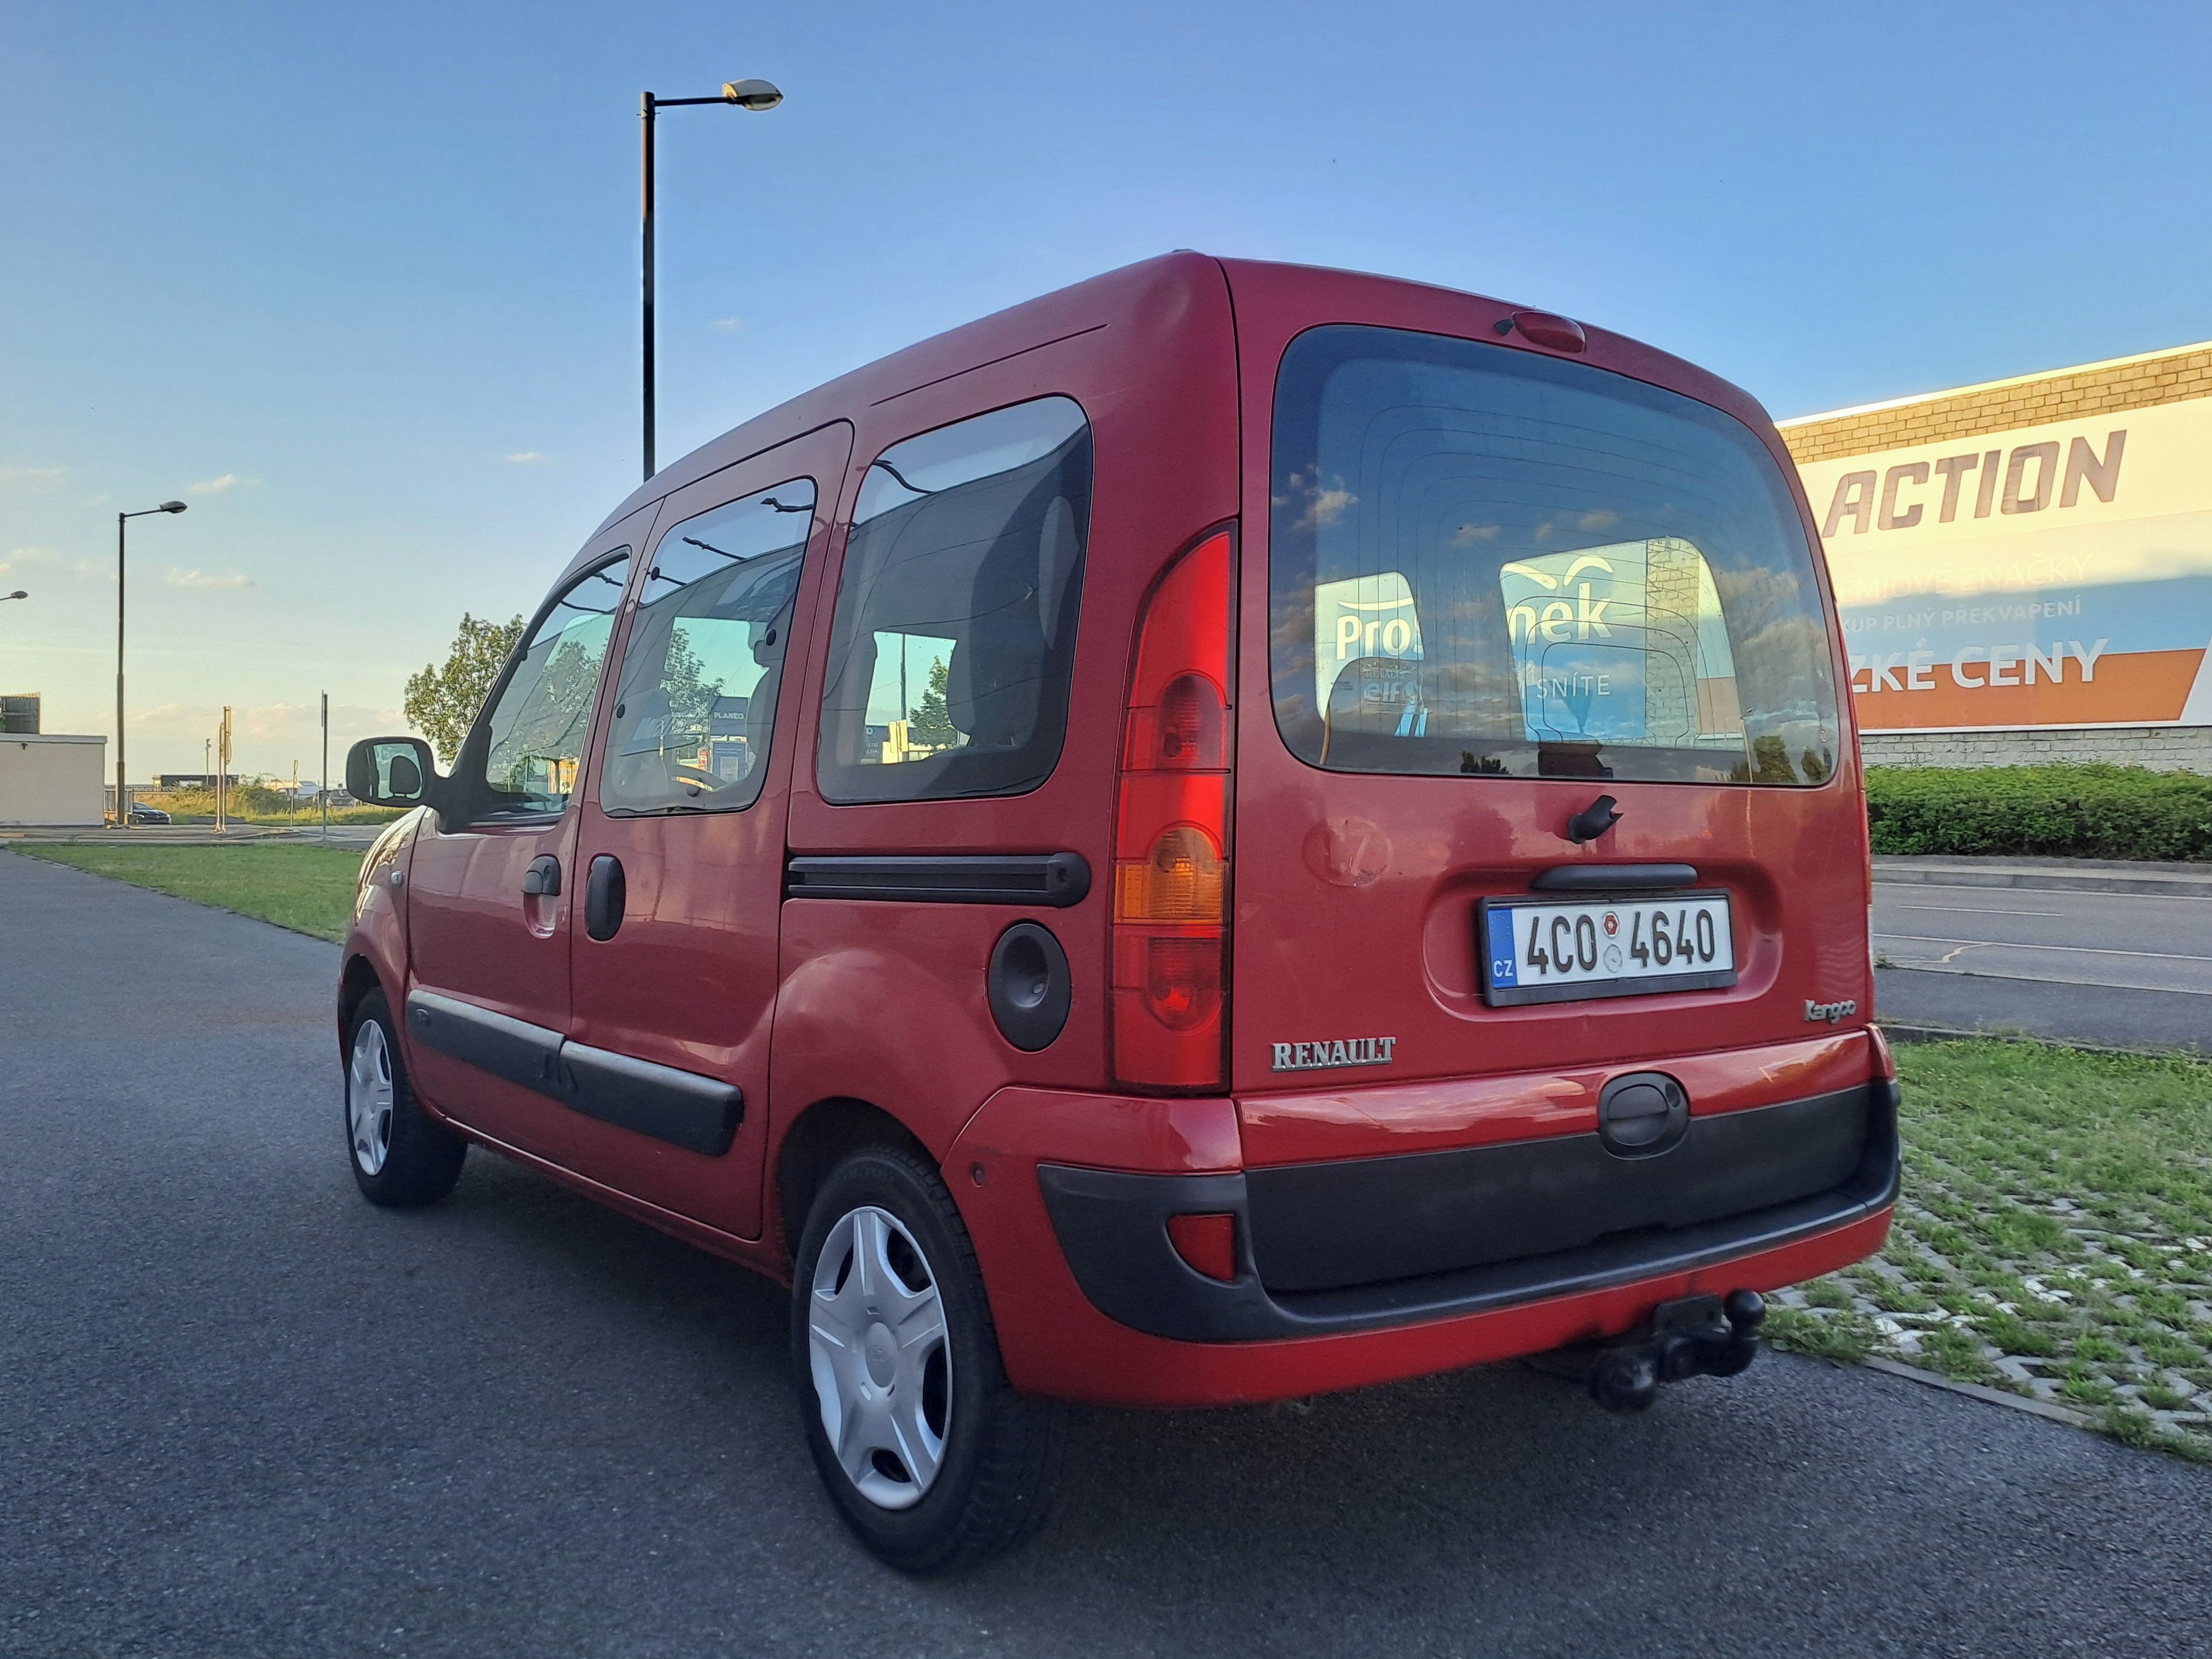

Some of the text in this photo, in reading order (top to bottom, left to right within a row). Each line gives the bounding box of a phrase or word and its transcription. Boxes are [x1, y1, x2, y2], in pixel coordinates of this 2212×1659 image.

[1822, 430, 2127, 538] ACTION
[1961, 552, 2093, 591] ZNAČKY
[1883, 608, 1934, 630] PLNÝ
[1942, 594, 2081, 625] PŘEKVAPENÍ
[1952, 638, 2109, 688] CENY
[1536, 672, 1611, 699] SNÍTE
[1631, 909, 1715, 967] 4640
[1493, 959, 1514, 978] CZ
[1804, 999, 1856, 1024] Kangoo
[1271, 1036, 1396, 1071] RENAULT
